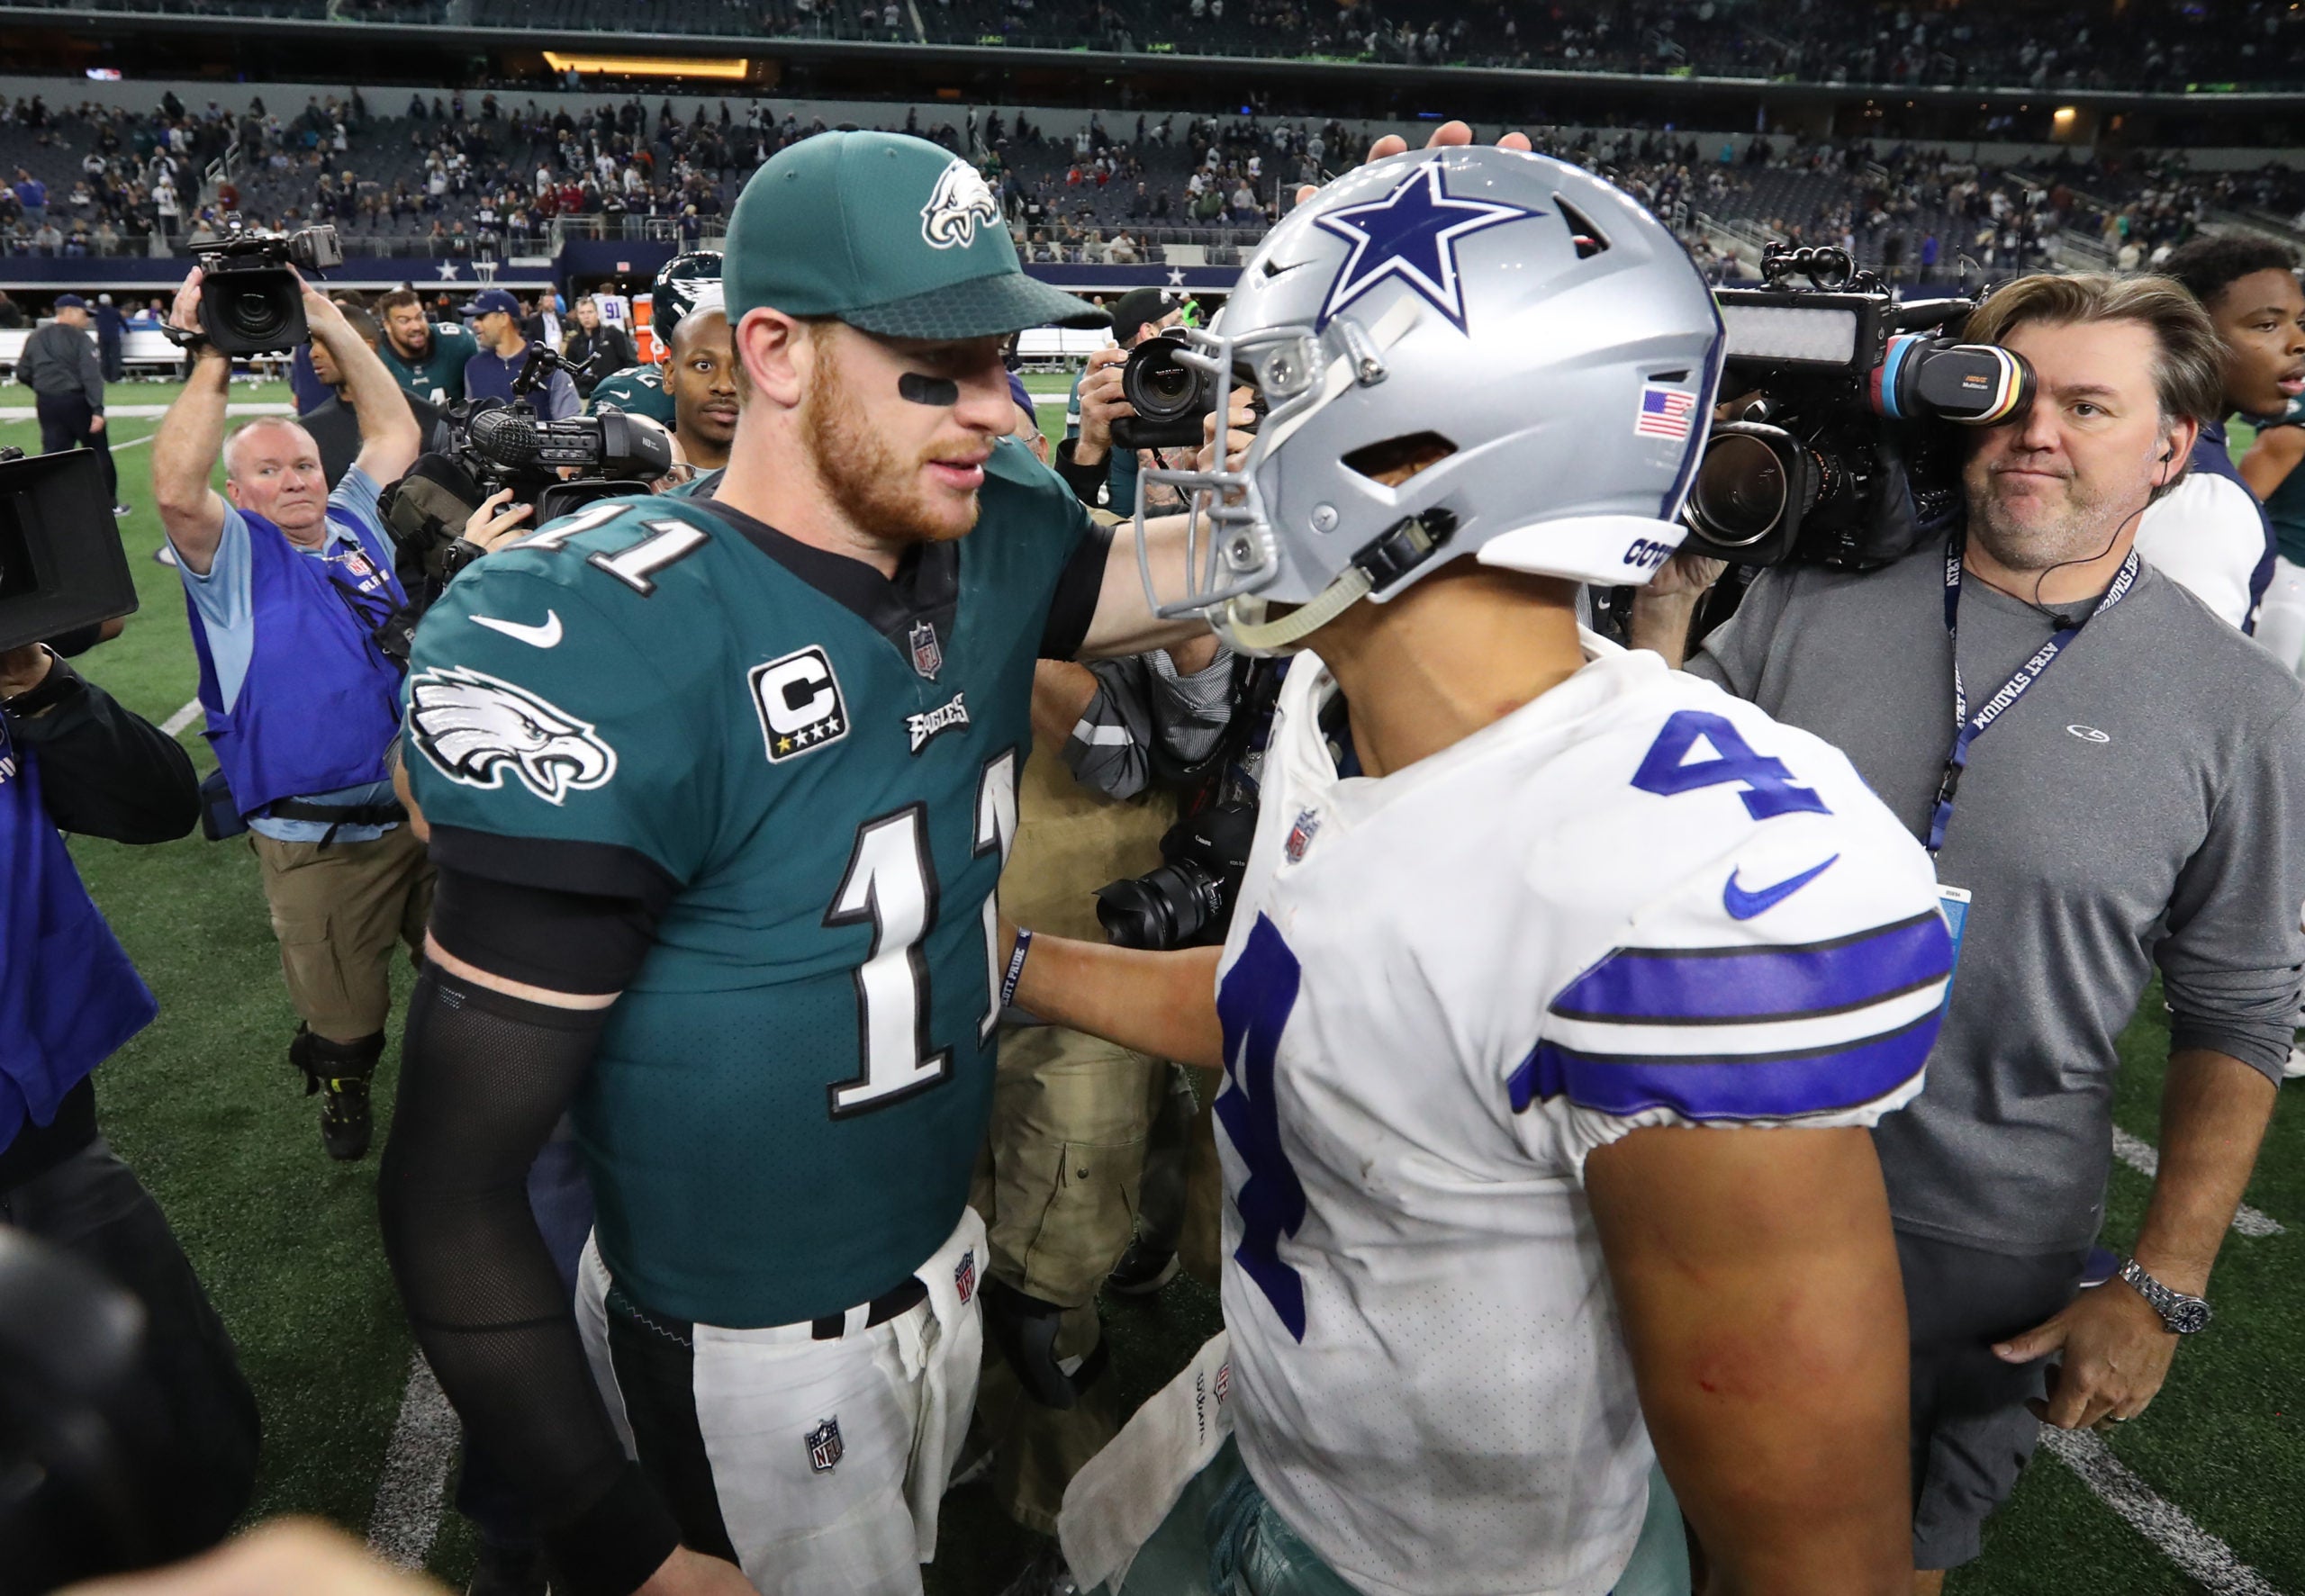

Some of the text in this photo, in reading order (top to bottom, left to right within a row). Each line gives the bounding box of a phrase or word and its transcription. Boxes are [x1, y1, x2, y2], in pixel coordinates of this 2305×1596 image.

[605, 302, 620, 320] 91
[503, 502, 712, 599] 11
[1946, 557, 1961, 587] AT&T
[759, 654, 836, 735] C
[1972, 641, 2059, 730] AT&T STADIUM
[1630, 709, 1835, 822] 4
[1195, 834, 1213, 848] Canon
[820, 746, 1020, 1122] 11
[1007, 947, 1026, 980] PRIDE
